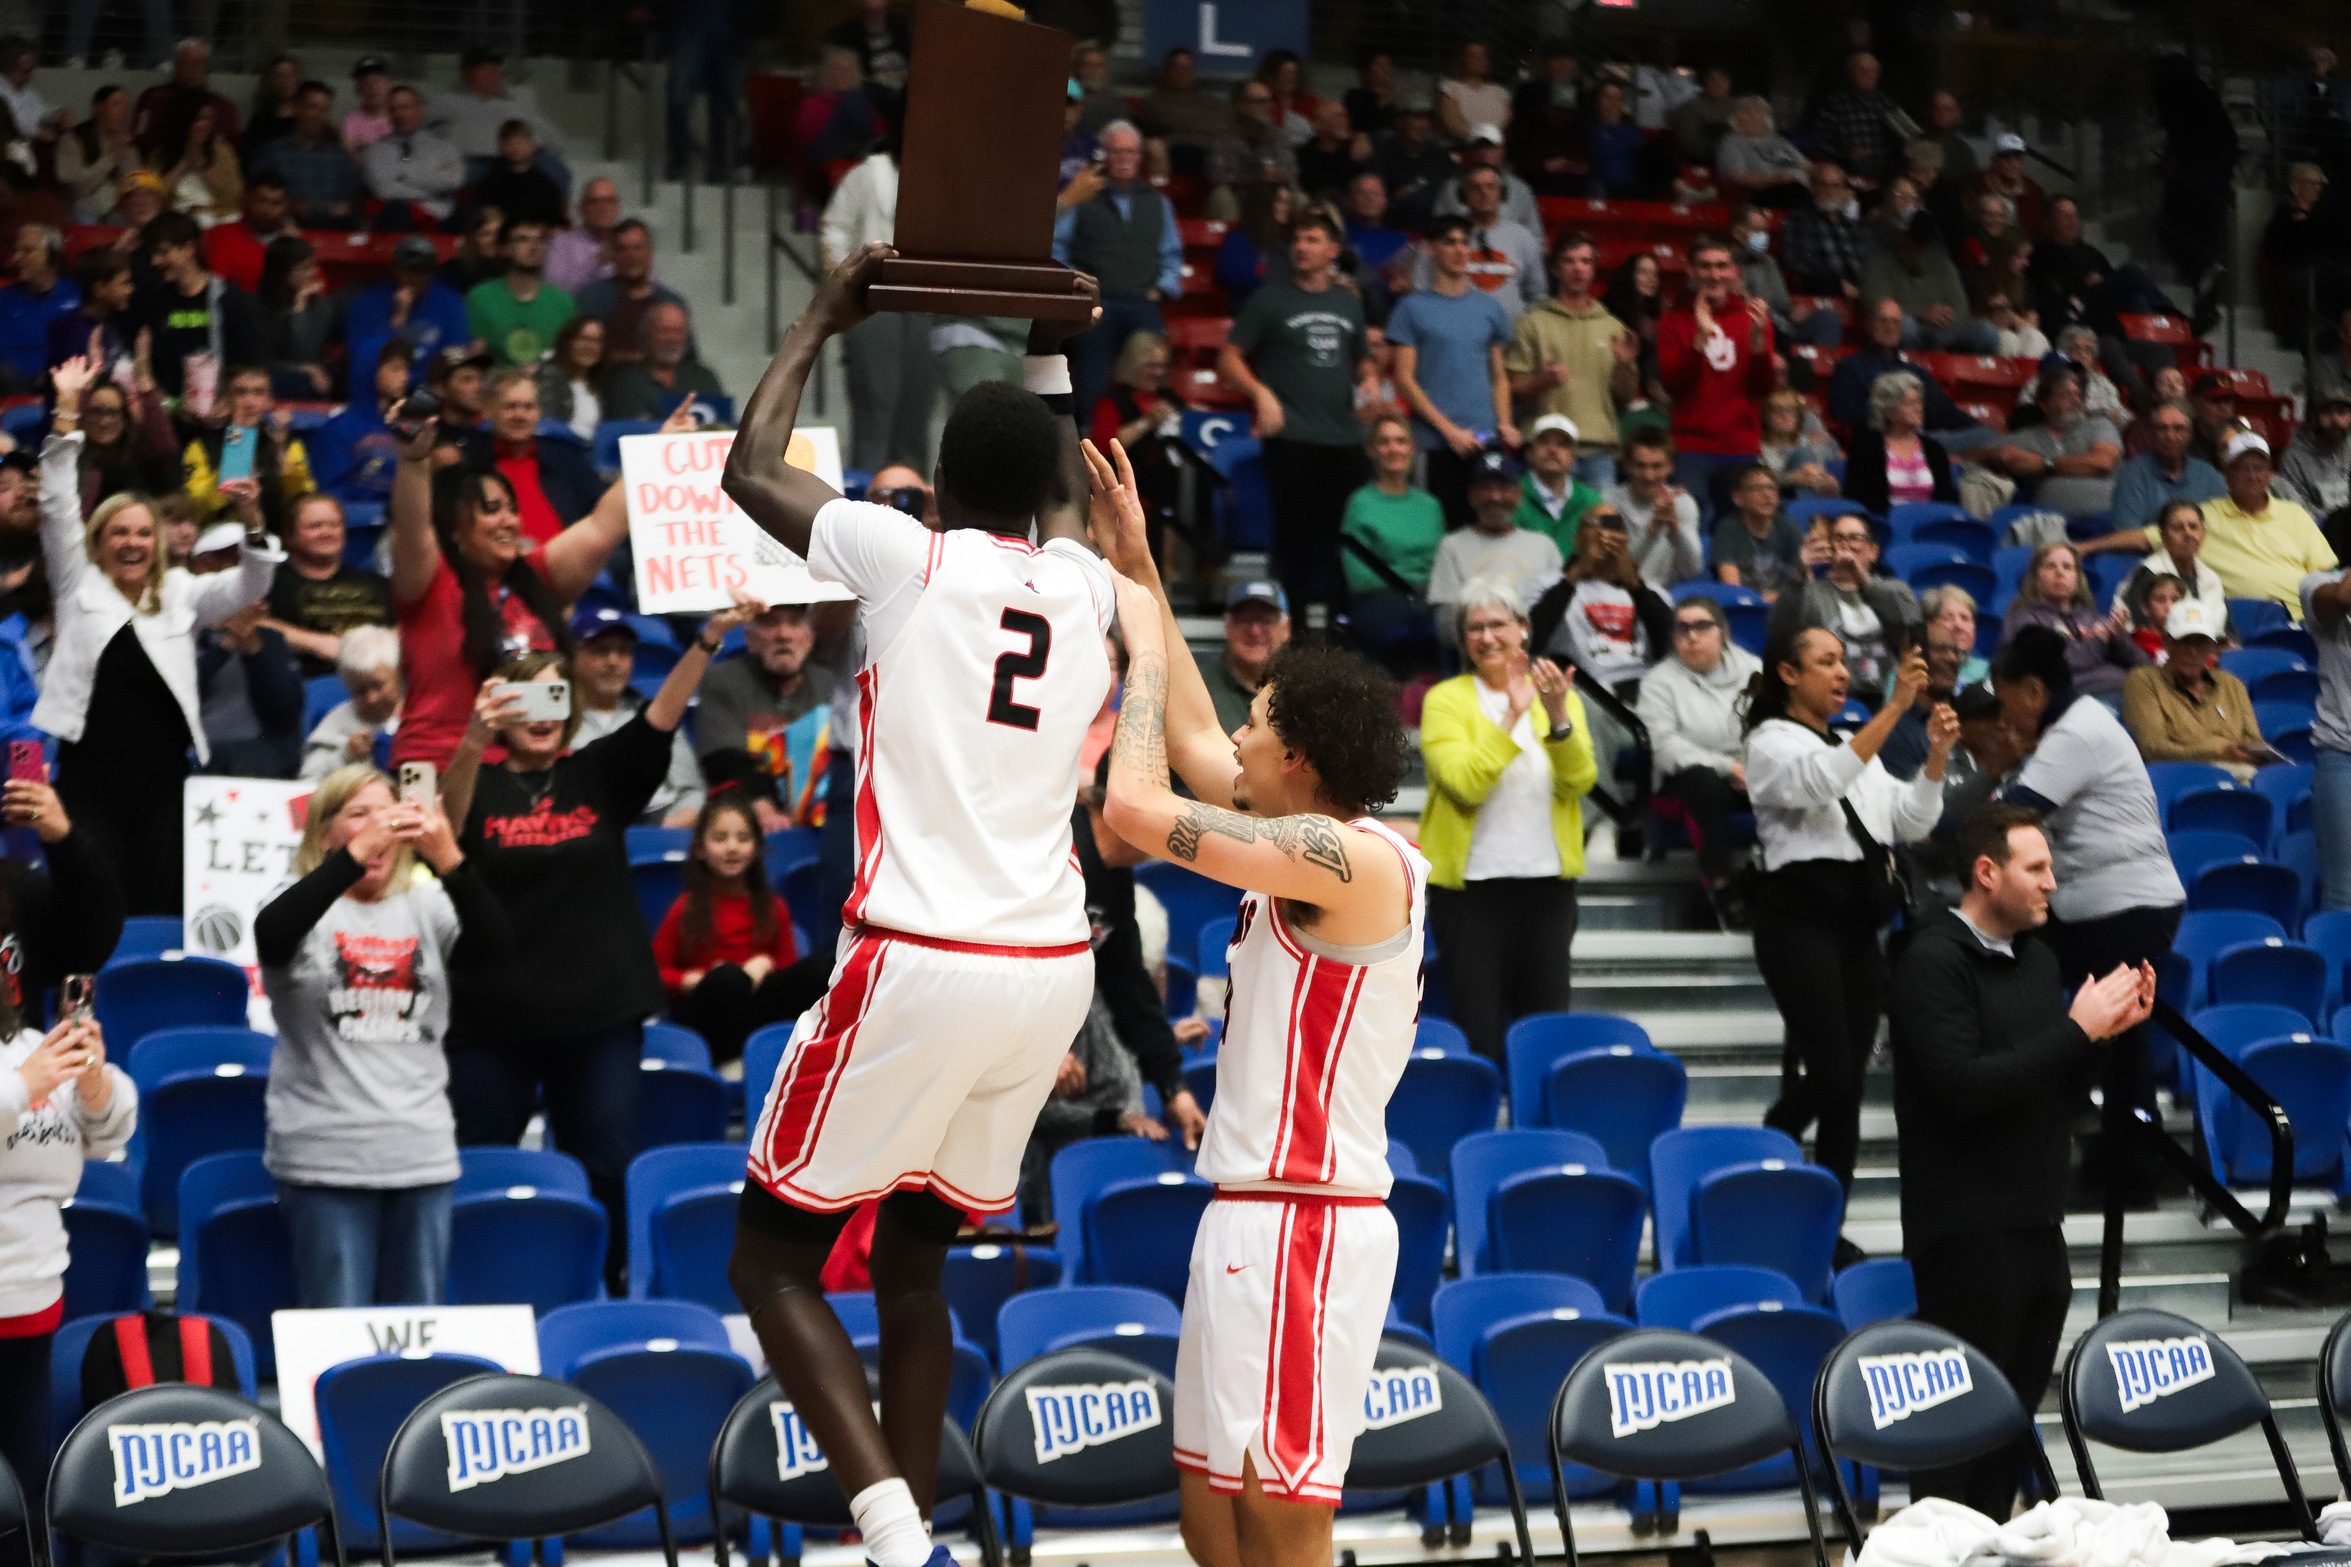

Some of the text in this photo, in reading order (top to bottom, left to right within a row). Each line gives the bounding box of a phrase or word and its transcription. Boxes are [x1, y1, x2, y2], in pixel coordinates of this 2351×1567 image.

[1199, 2, 1252, 57] L
[663, 437, 733, 476] CUT
[656, 520, 727, 547] THE
[644, 552, 748, 596] NETS
[985, 605, 1052, 733] 2
[1363, 1376, 1433, 1421] CAA
[1612, 1369, 1727, 1427] NJCAA
[1866, 1358, 1966, 1419] NJCAA
[2113, 1344, 2208, 1402] NJCAA
[451, 1417, 581, 1480] NJCAA
[1034, 1390, 1153, 1452] NJCAA
[117, 1430, 251, 1496] NJCAA
